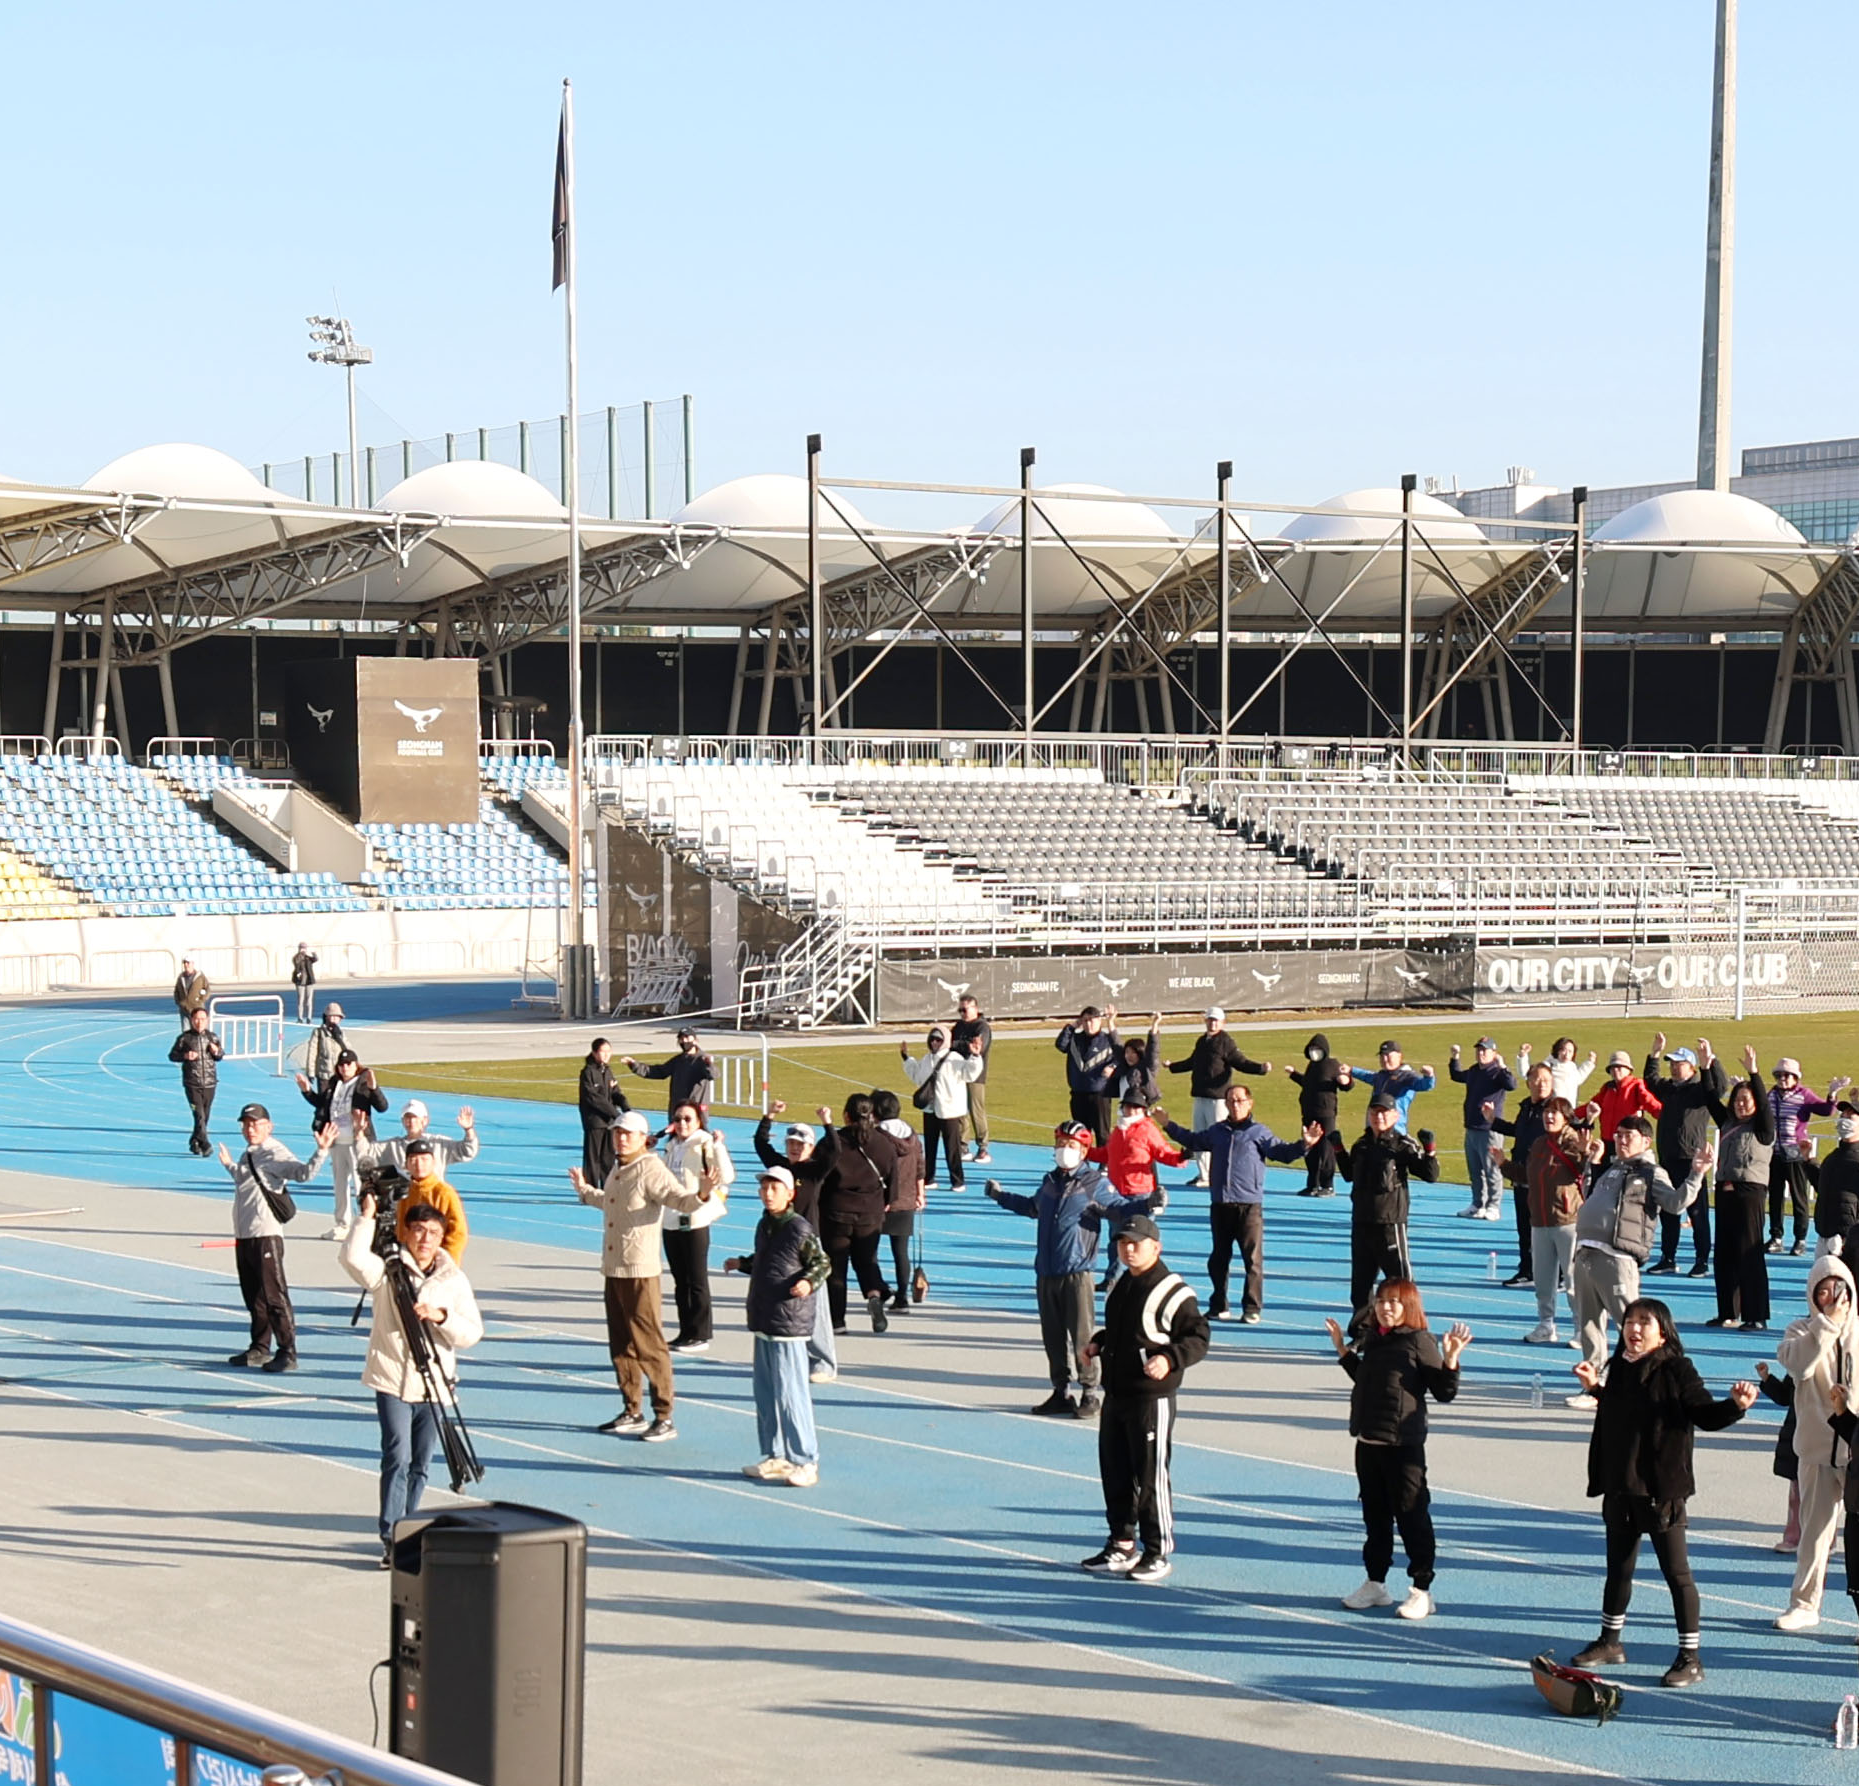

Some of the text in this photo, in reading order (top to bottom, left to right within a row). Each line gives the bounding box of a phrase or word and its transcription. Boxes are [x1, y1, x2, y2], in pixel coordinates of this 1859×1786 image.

[397, 740, 443, 749] SEONGNAM
[1488, 956, 1622, 994] OUR CITY
[1657, 954, 1715, 989] OUR
[1168, 977, 1215, 989] WE ARE BLACK
[1318, 973, 1361, 984] SEONGNAM FC
[1011, 981, 1060, 994] SEONGNAM FC
